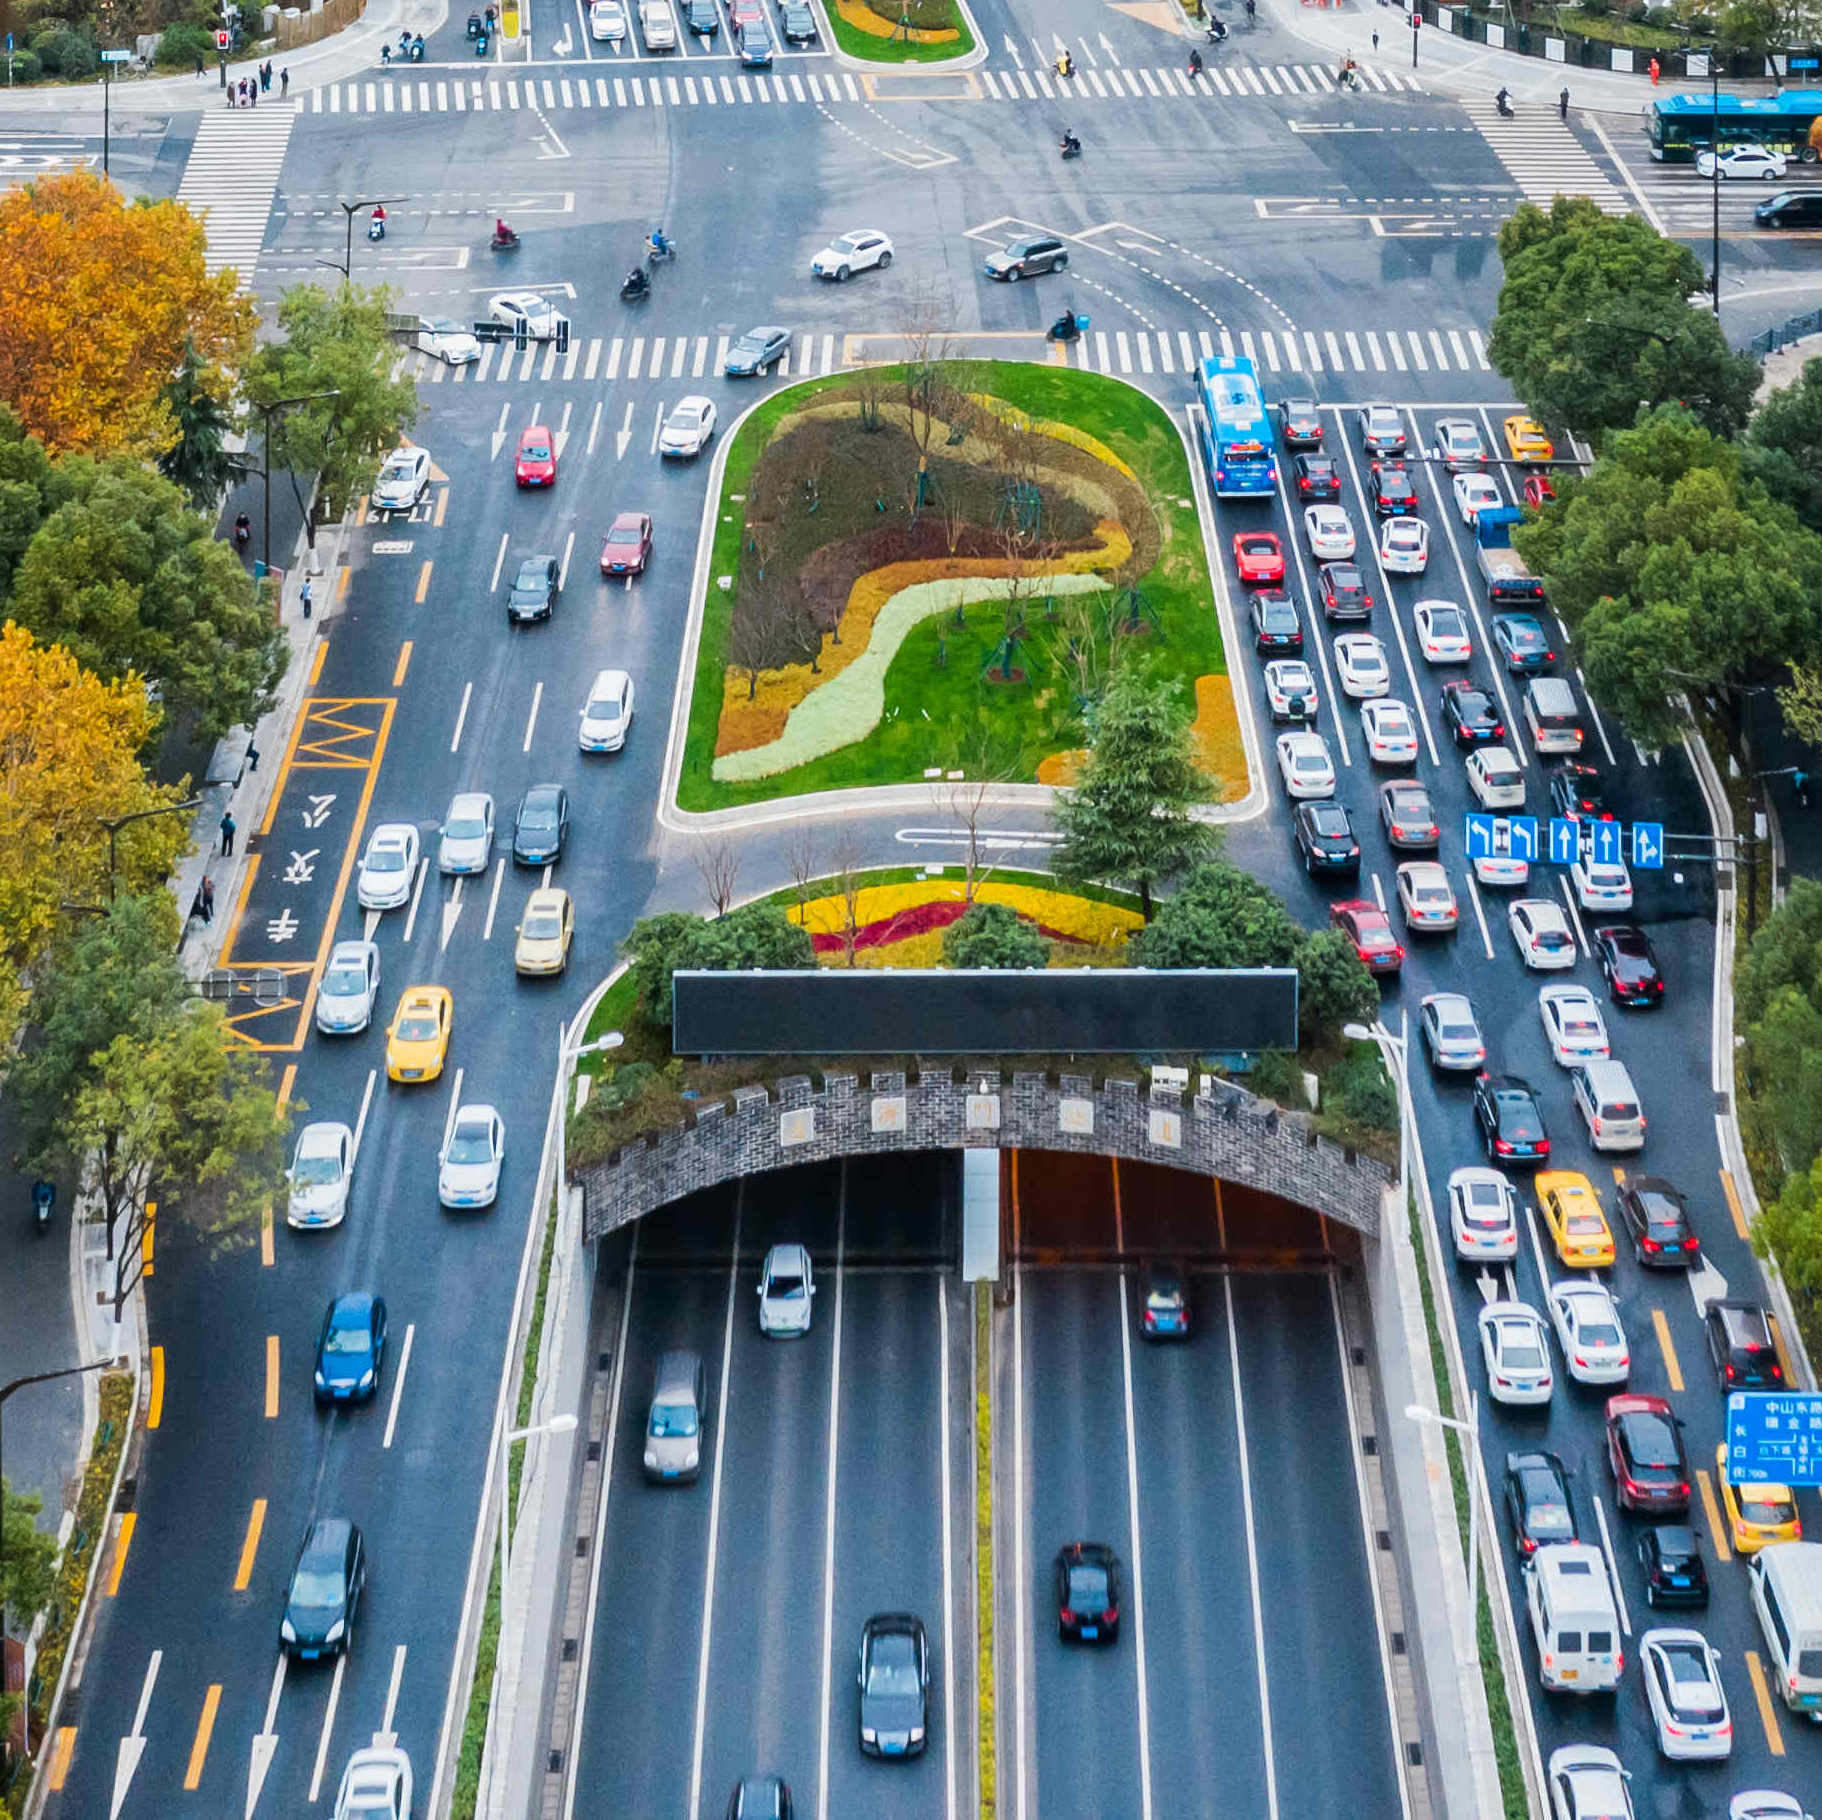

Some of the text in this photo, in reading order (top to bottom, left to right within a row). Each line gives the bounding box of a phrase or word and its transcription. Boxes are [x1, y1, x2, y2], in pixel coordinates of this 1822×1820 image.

[266, 793, 337, 944] 公交车
[1766, 1401, 1822, 1415] 中山东路
[1733, 1424, 1747, 1478] 长白街
